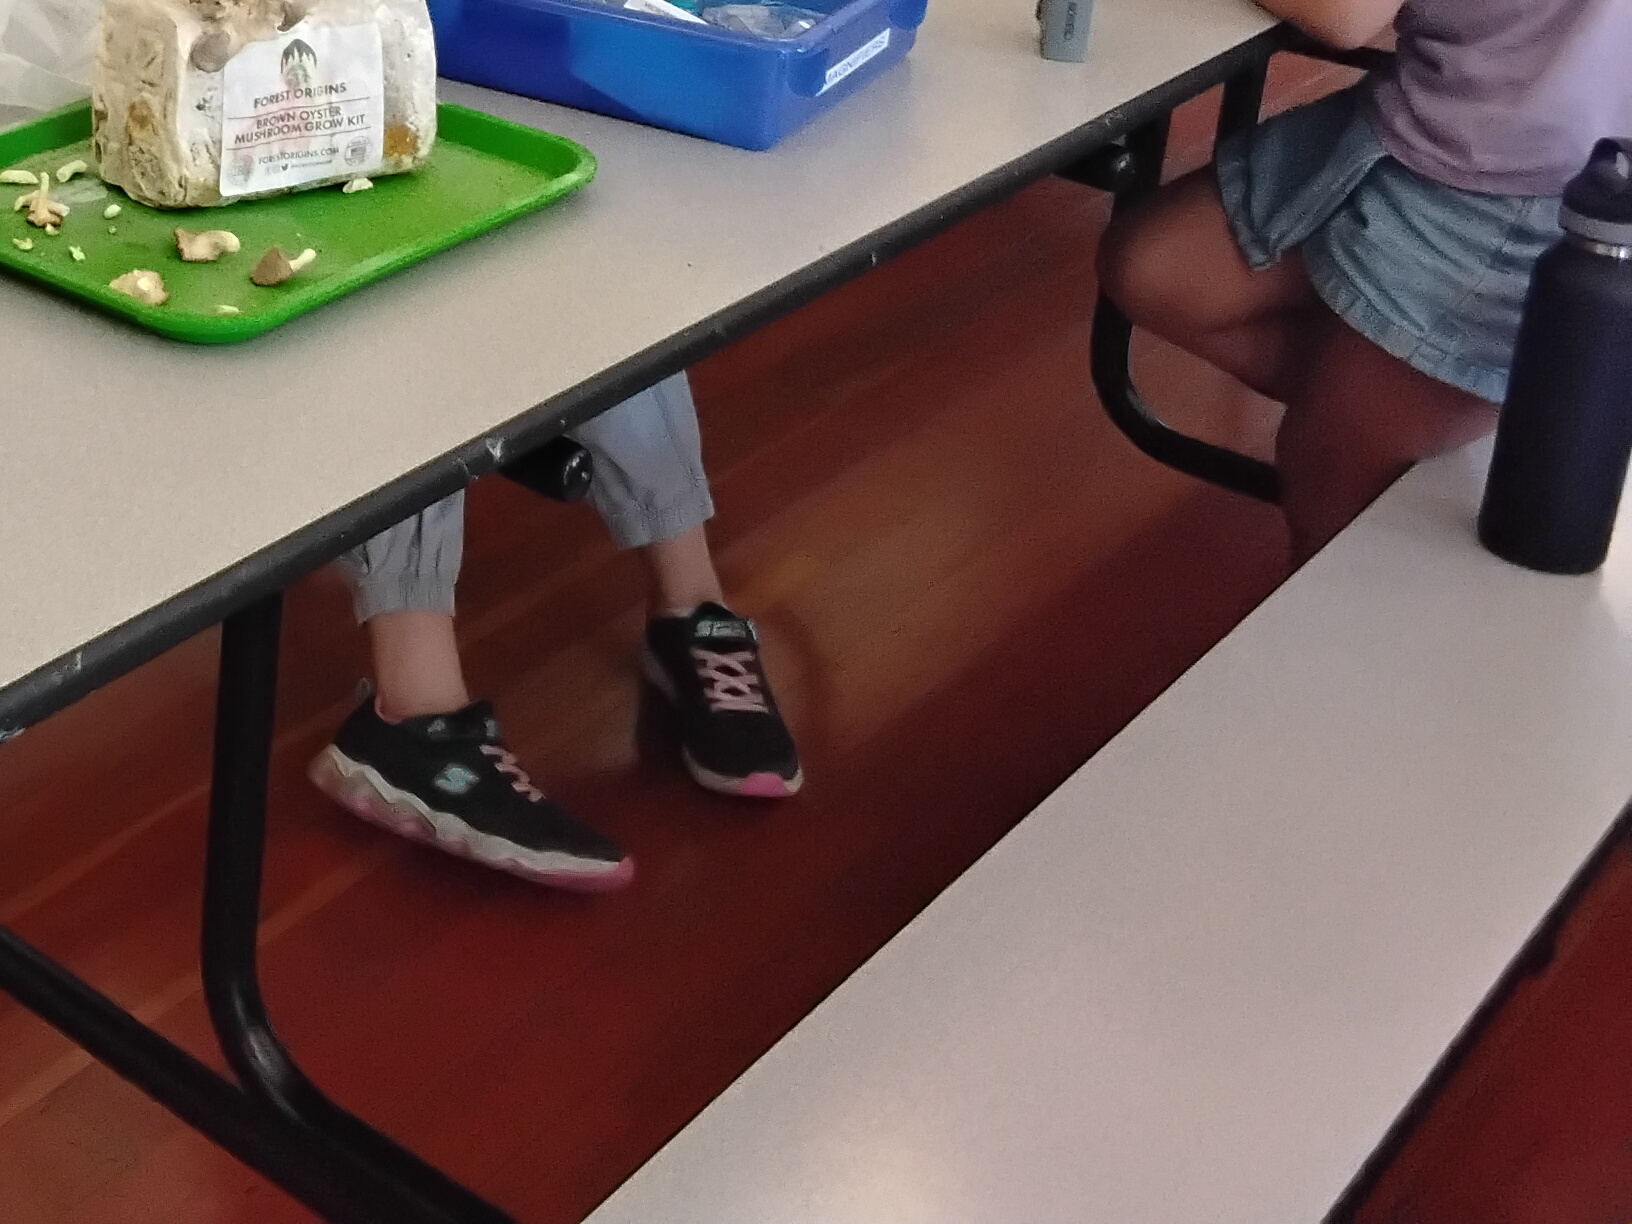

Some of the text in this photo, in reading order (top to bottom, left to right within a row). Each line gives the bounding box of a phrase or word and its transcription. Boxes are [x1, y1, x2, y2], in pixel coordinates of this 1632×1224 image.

[254, 82, 347, 109] FOREST ORIGINS
[234, 114, 365, 144] MUSHROOM GROW KIT
[256, 105, 341, 129] BROWN OYSTER
